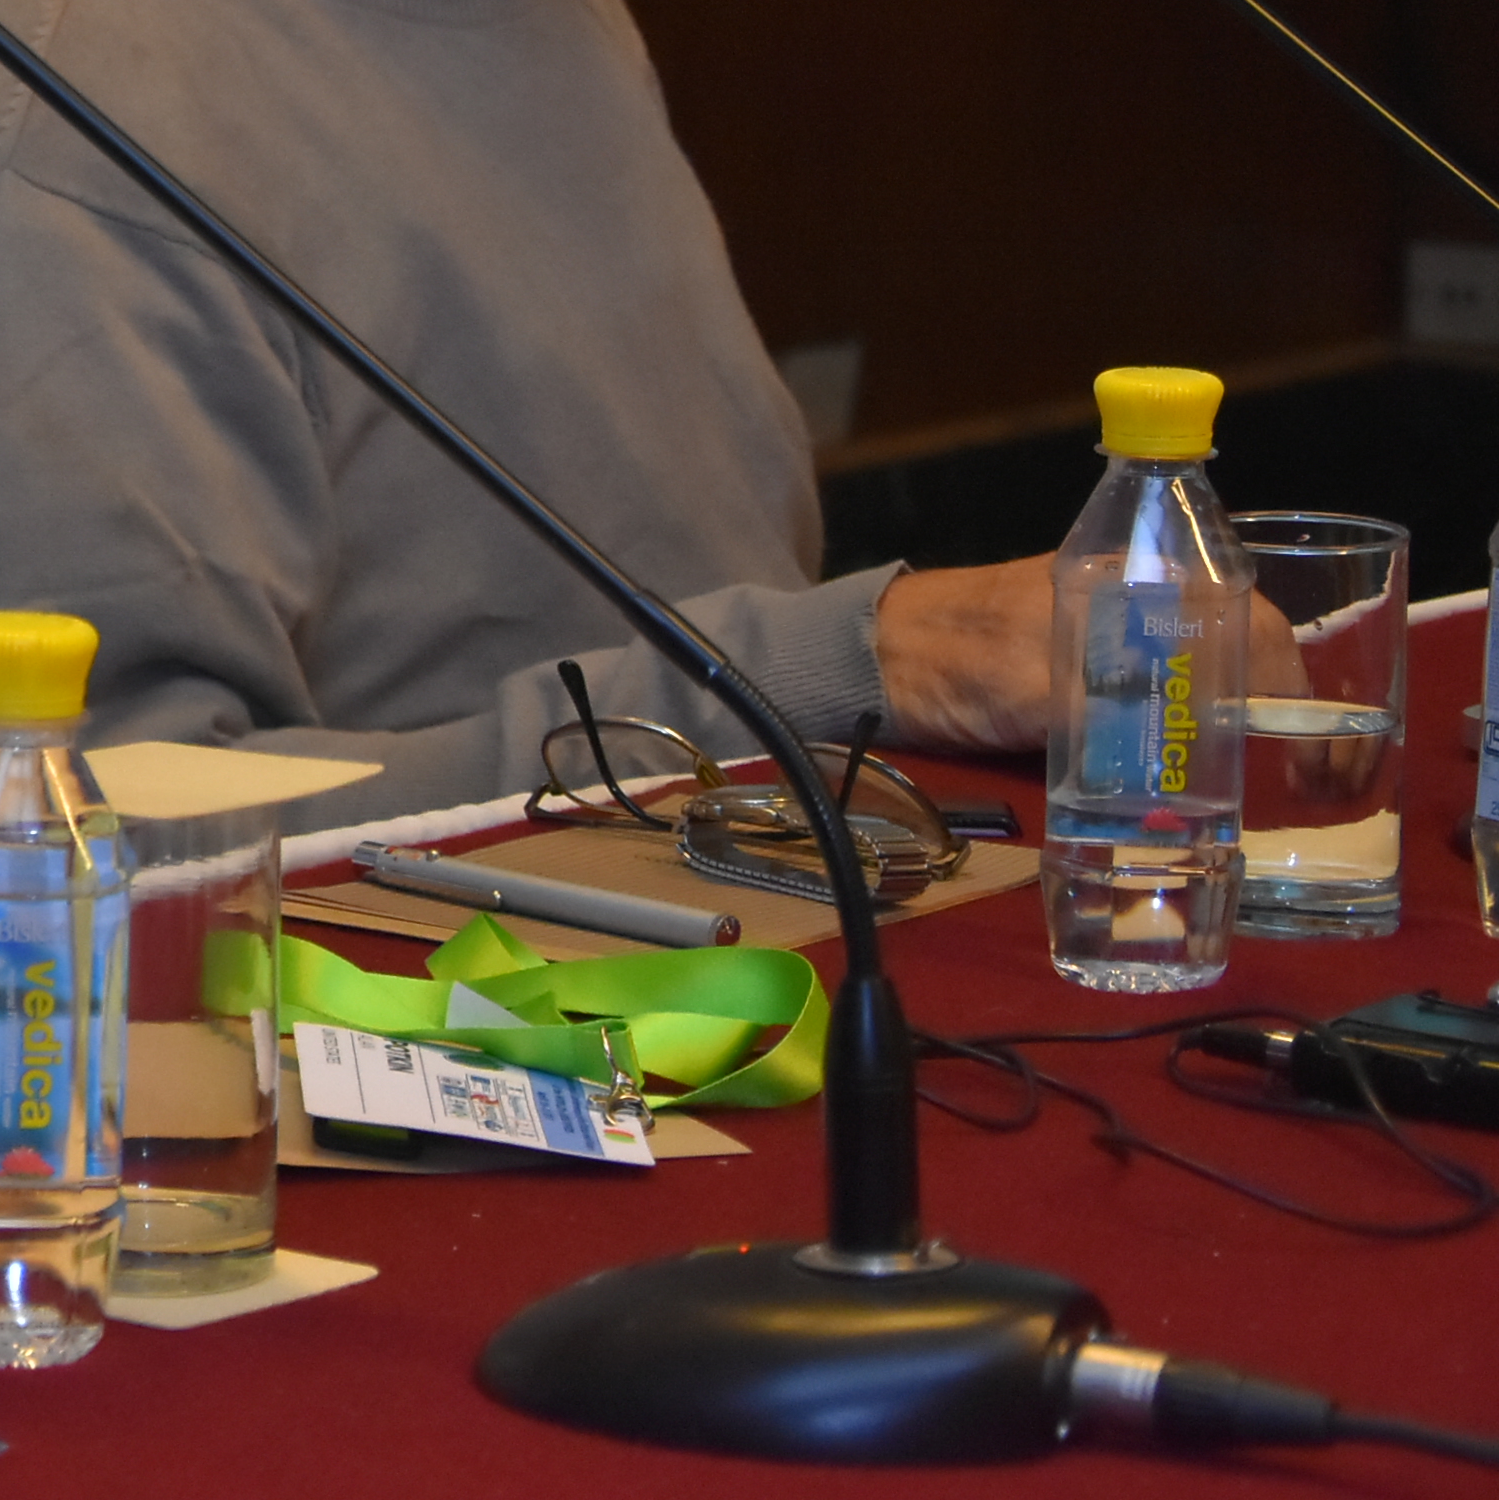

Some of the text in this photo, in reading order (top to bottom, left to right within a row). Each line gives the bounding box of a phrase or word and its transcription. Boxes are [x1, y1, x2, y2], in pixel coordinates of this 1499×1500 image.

[1143, 616, 1204, 639] Bisleri
[1146, 692, 1161, 763] mountain
[1159, 652, 1199, 794] vedica
[19, 960, 63, 1130] vedica
